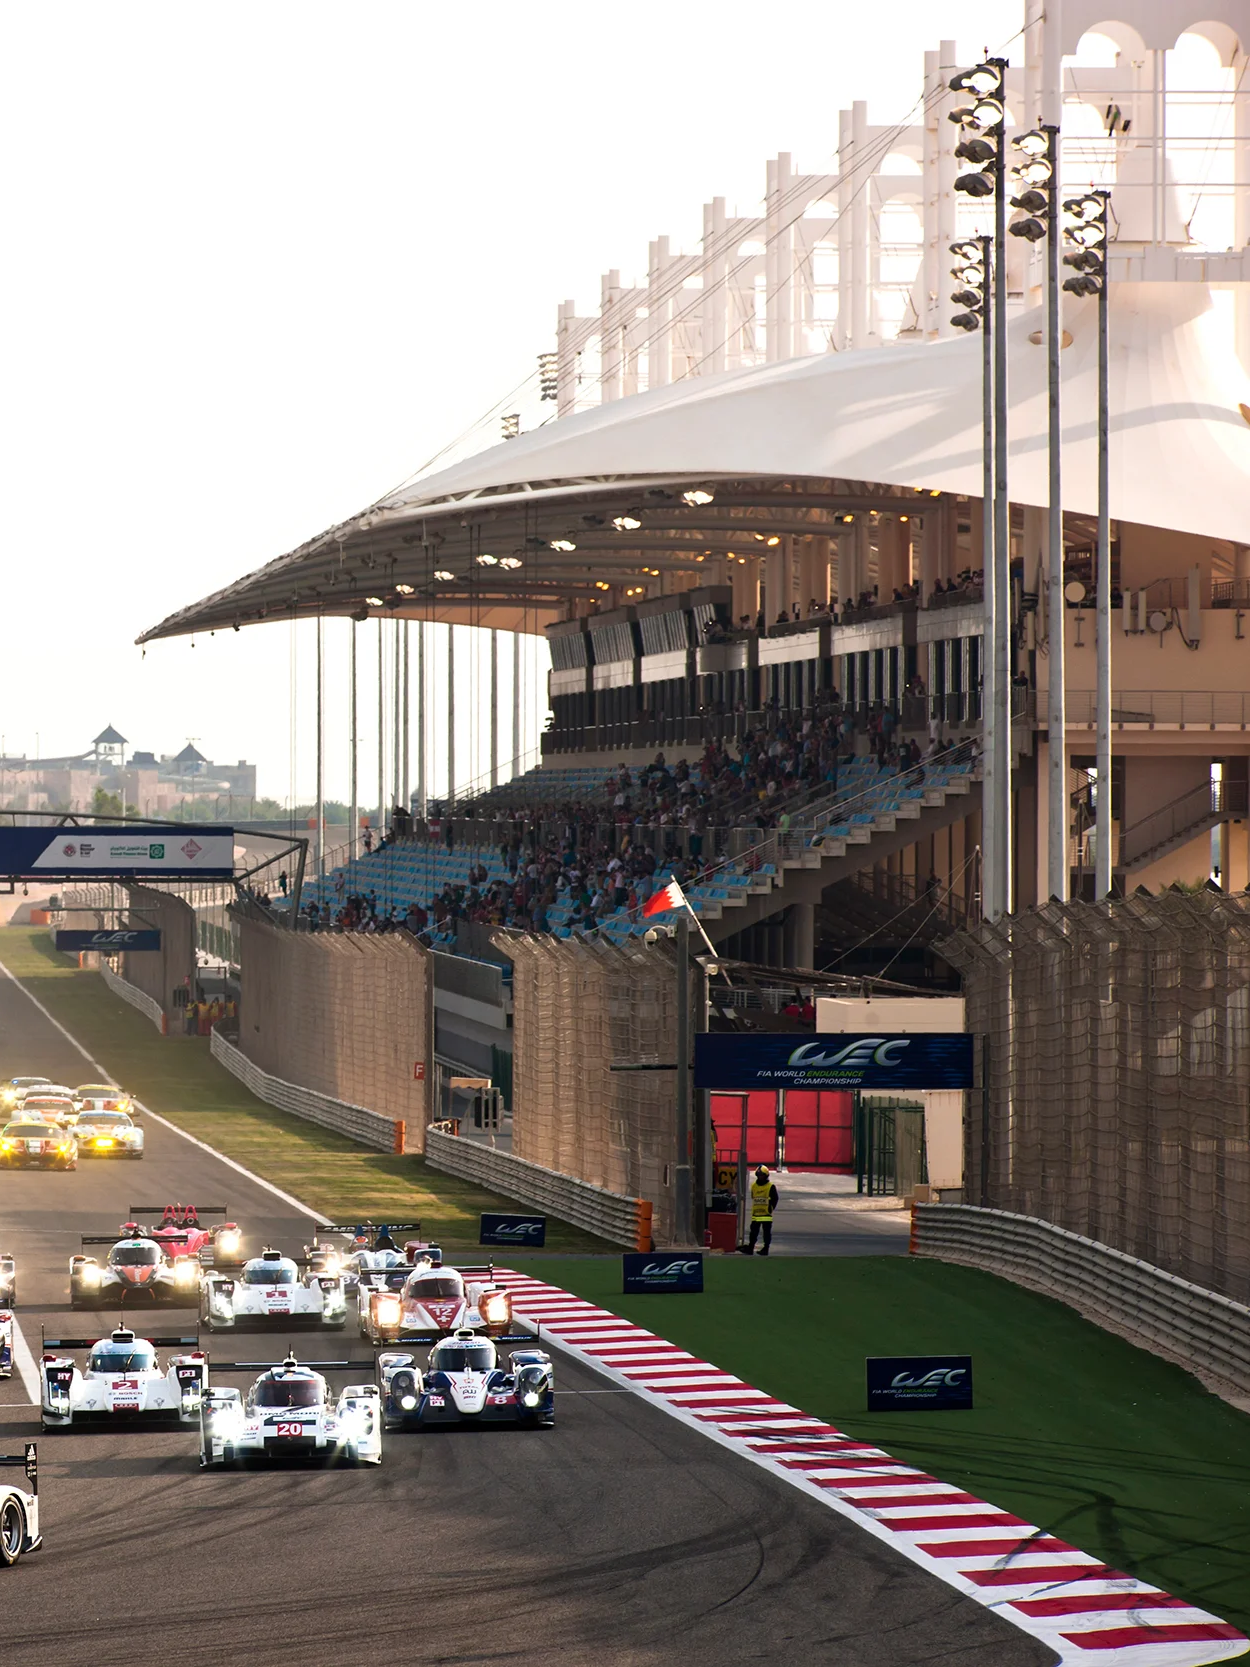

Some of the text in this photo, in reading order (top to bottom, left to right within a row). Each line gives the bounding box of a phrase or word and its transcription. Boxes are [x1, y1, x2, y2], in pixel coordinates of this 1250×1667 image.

[90, 931, 138, 943] WEC
[787, 1038, 911, 1067] WEC
[416, 1064, 424, 1077] F
[793, 1077, 862, 1085] CHAMPIONSHIP
[494, 1223, 543, 1235] WEC
[641, 1260, 700, 1275] WEC
[432, 1308, 452, 1316] 12
[57, 1372, 71, 1381] HY
[891, 1368, 967, 1387] WEC
[117, 1381, 133, 1390] 2
[494, 1396, 507, 1404] 8
[278, 1423, 301, 1436] 20
